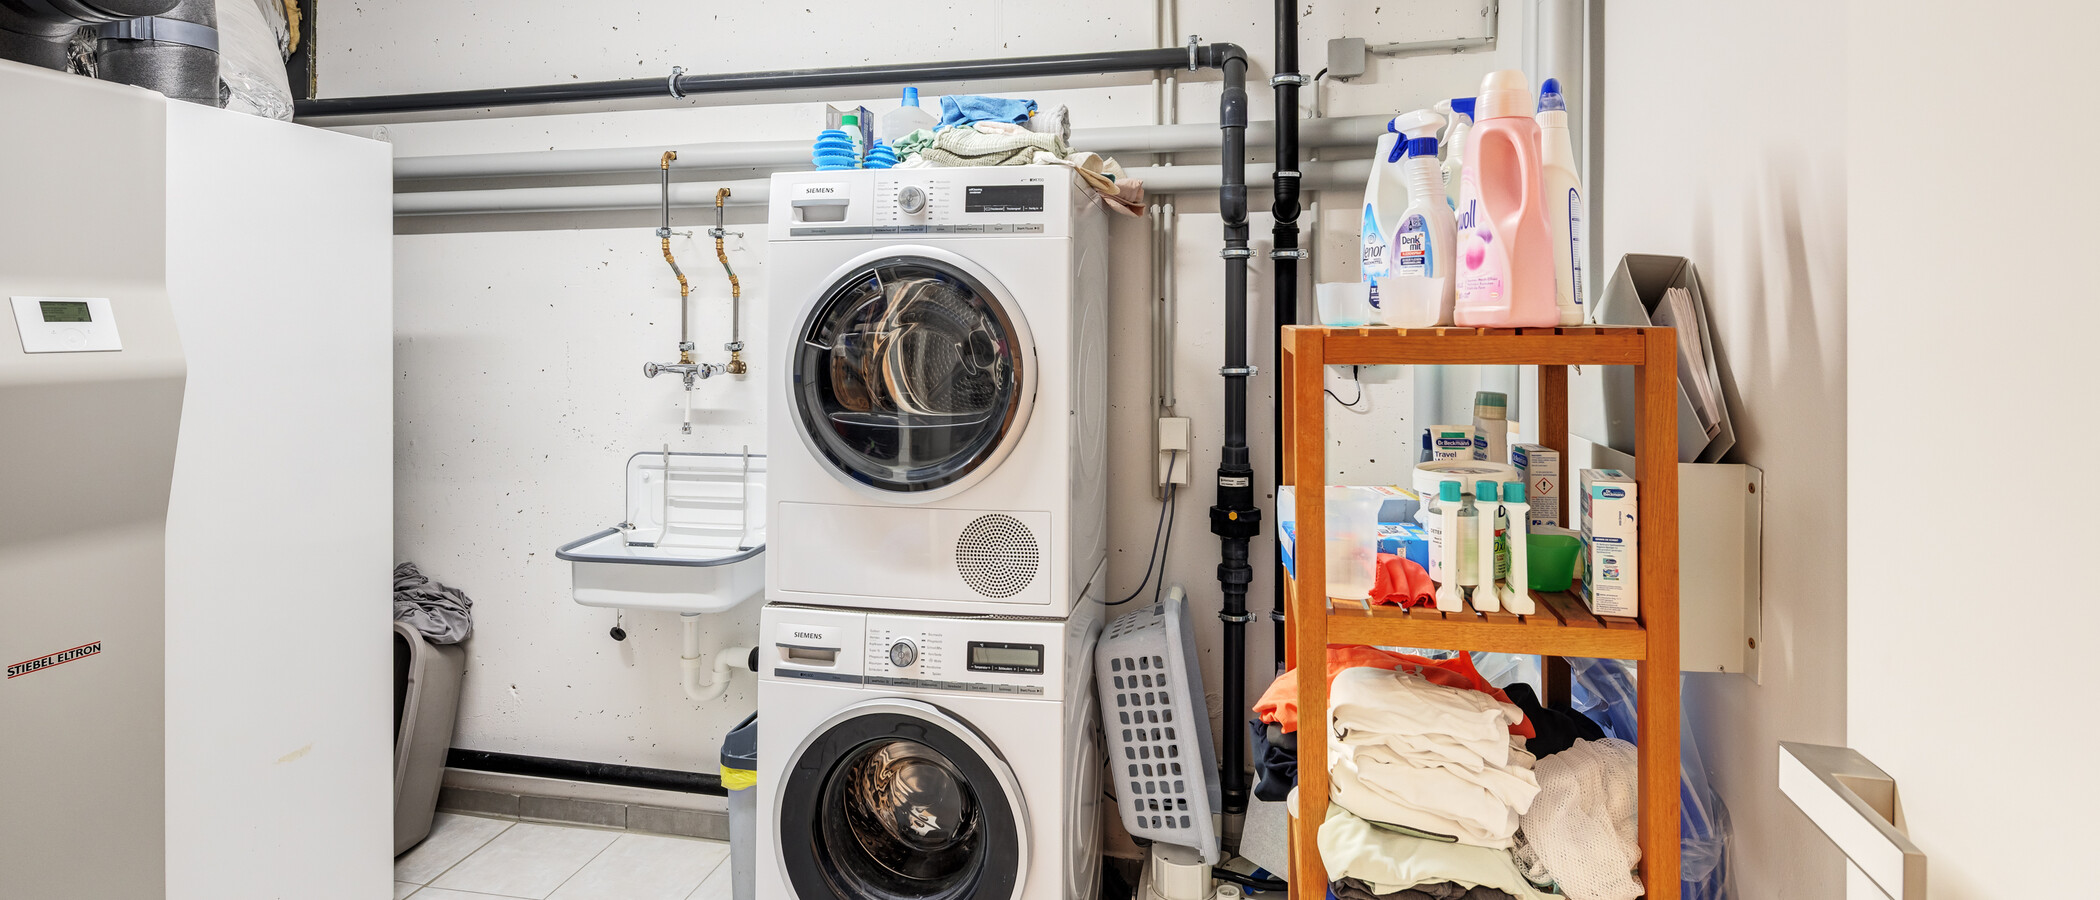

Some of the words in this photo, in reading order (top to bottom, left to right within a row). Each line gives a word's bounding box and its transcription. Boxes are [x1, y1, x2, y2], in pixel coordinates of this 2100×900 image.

[1401, 235, 1420, 245] Denk
[1409, 243, 1422, 251] mit
[794, 631, 823, 640] SIEMENS
[7, 656, 55, 677] STIEBEL
[57, 643, 101, 662] ELTRON
